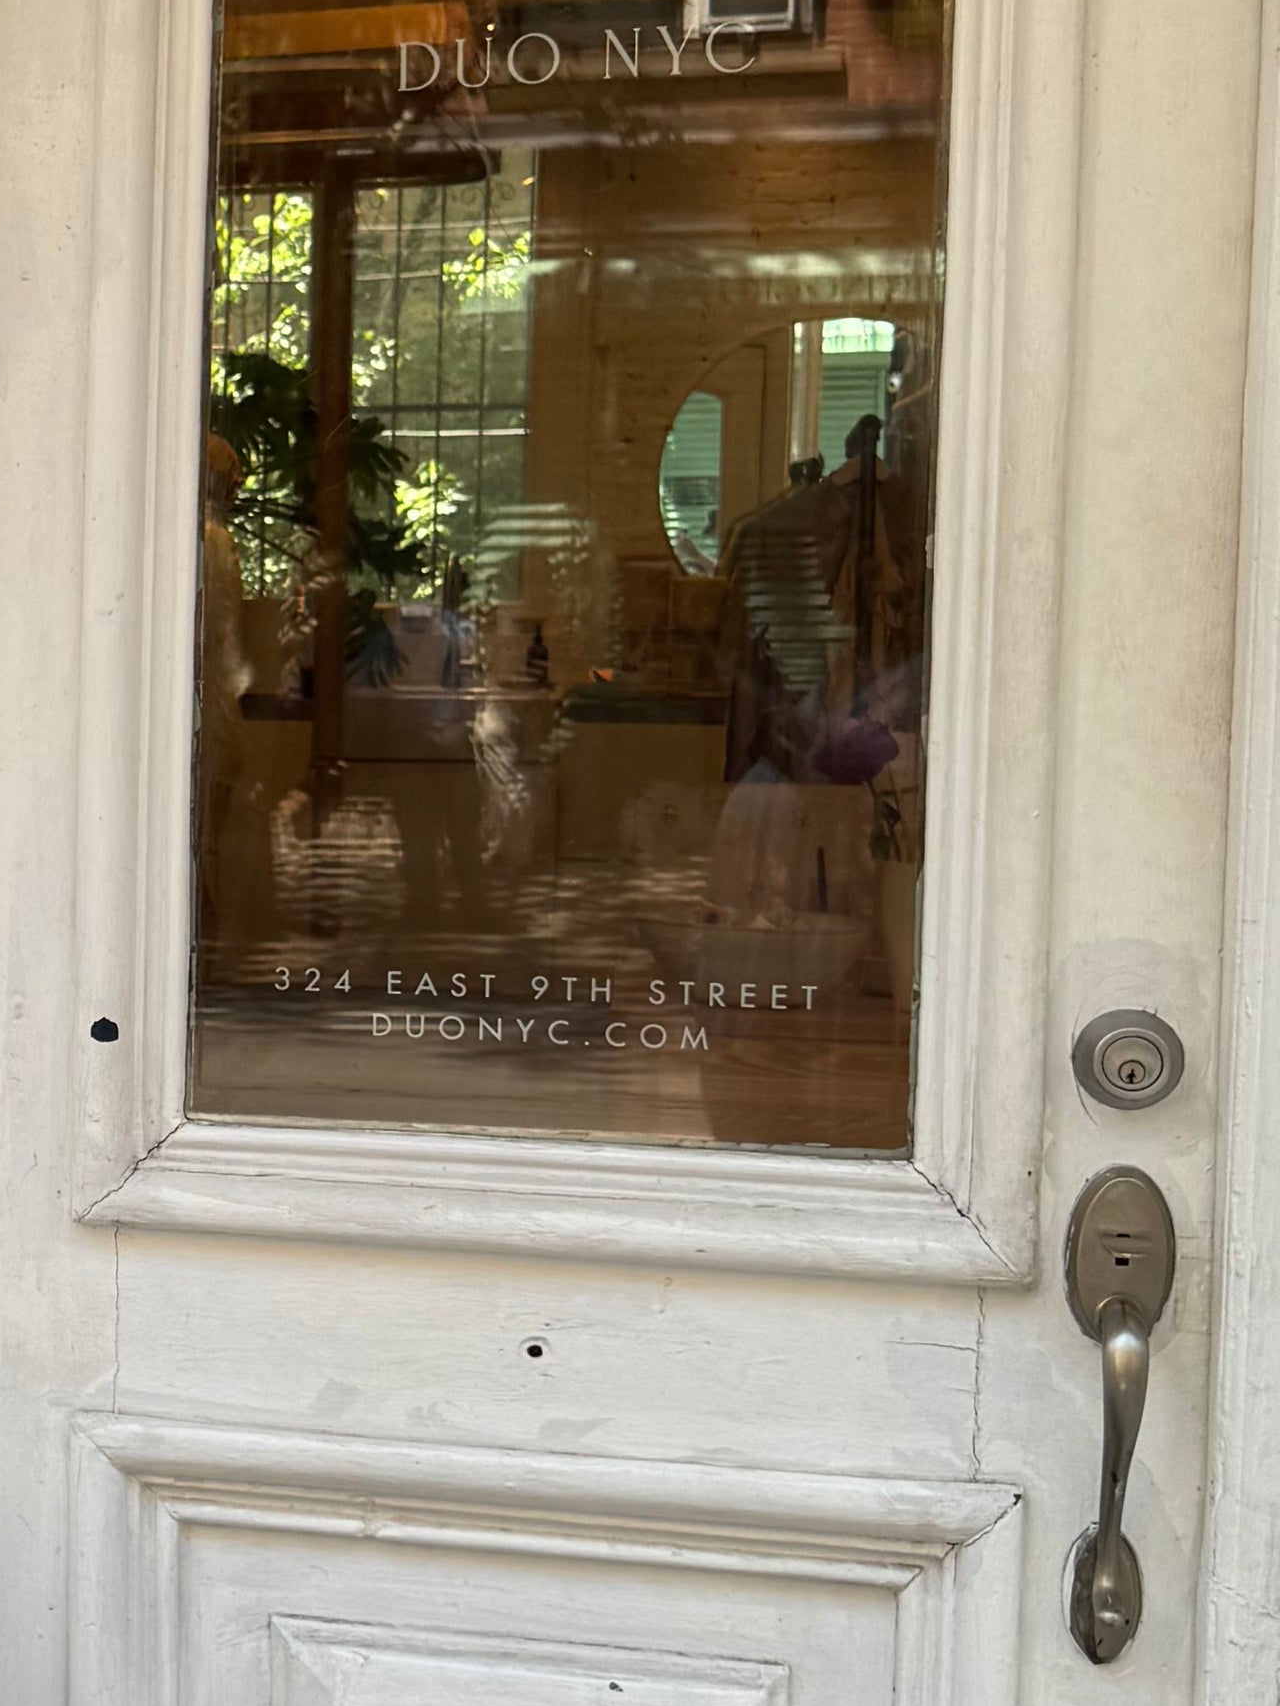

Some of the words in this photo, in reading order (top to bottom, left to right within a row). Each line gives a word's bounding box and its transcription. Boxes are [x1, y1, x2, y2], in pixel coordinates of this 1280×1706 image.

[396, 32, 561, 92] DUO
[603, 21, 757, 80] NYC
[274, 966, 352, 993] 324
[387, 970, 497, 999] EAST
[531, 975, 611, 1003] 9TH
[648, 979, 819, 1011] STREET
[372, 1012, 709, 1051] DUONYC.COM
